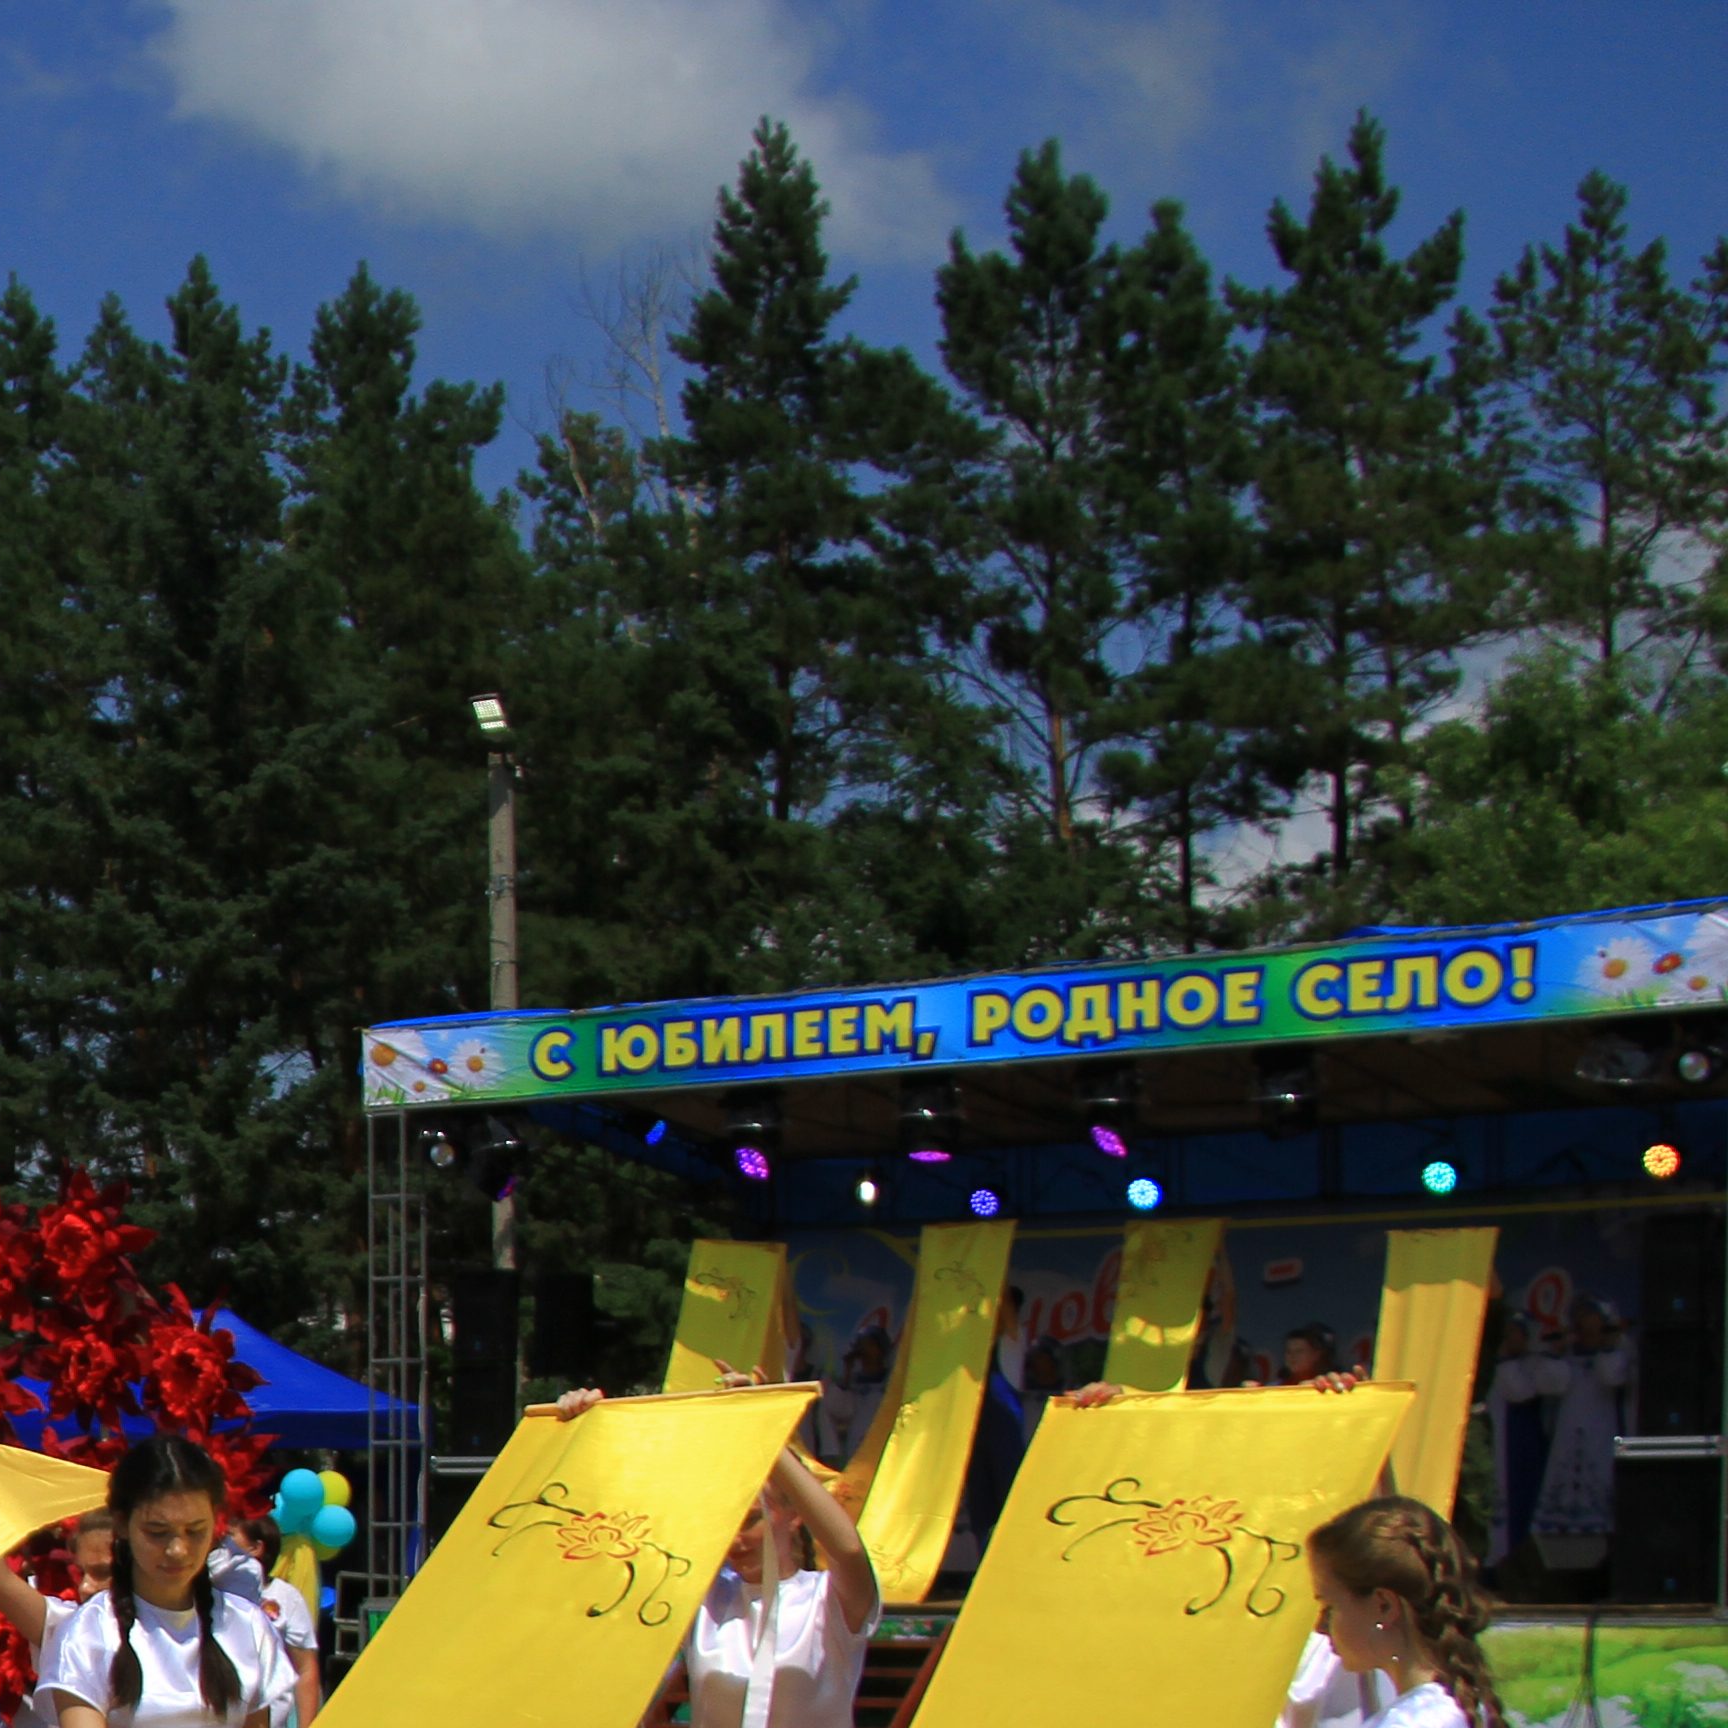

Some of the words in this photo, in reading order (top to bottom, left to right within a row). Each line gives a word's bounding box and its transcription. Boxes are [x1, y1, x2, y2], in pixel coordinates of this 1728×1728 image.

[532, 1030, 574, 1078] С
[602, 1001, 935, 1073] ЮБИЛЕЕМ,
[972, 970, 1260, 1043] РОДНОЕ
[1295, 946, 1535, 1017] СЕЛО!
